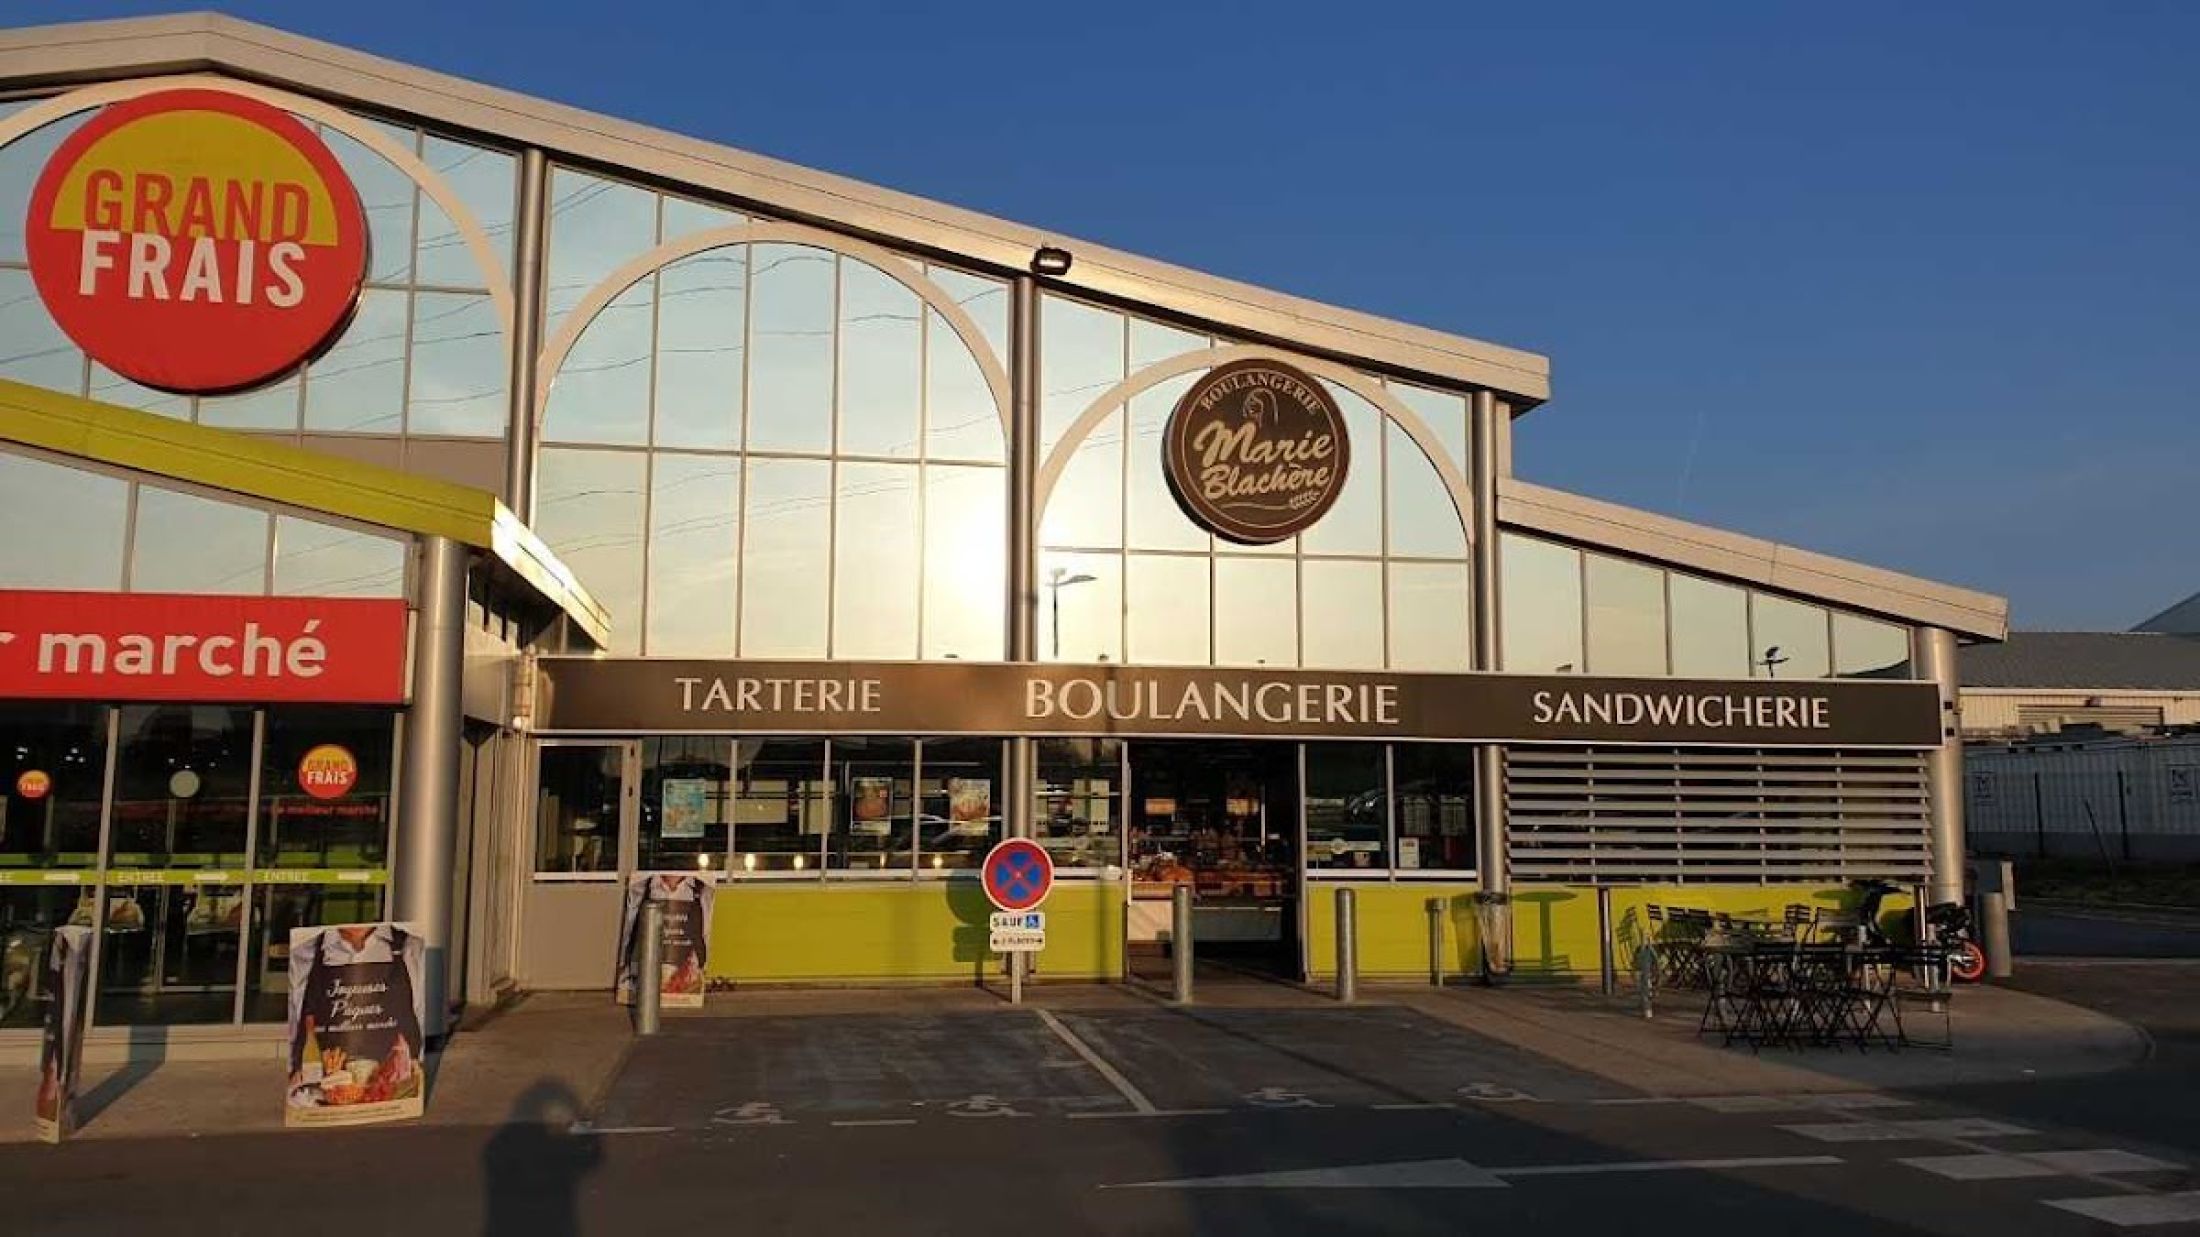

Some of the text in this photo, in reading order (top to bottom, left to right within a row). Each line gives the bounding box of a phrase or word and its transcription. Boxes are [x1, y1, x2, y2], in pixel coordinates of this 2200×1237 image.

[83, 169, 310, 246] GRAND
[78, 228, 307, 308] FRAIS
[1201, 371, 1322, 415] BOULANGERIE
[1193, 419, 1334, 468] Marie
[1201, 462, 1330, 500] Blachère
[37, 619, 327, 678] marché
[674, 677, 881, 713] TARTERIE
[1024, 678, 1400, 725] BOULANGERIE
[1532, 690, 1831, 730] SANDWICHERIE
[306, 770, 349, 786] FRAIS
[992, 916, 1023, 928] SAUF
